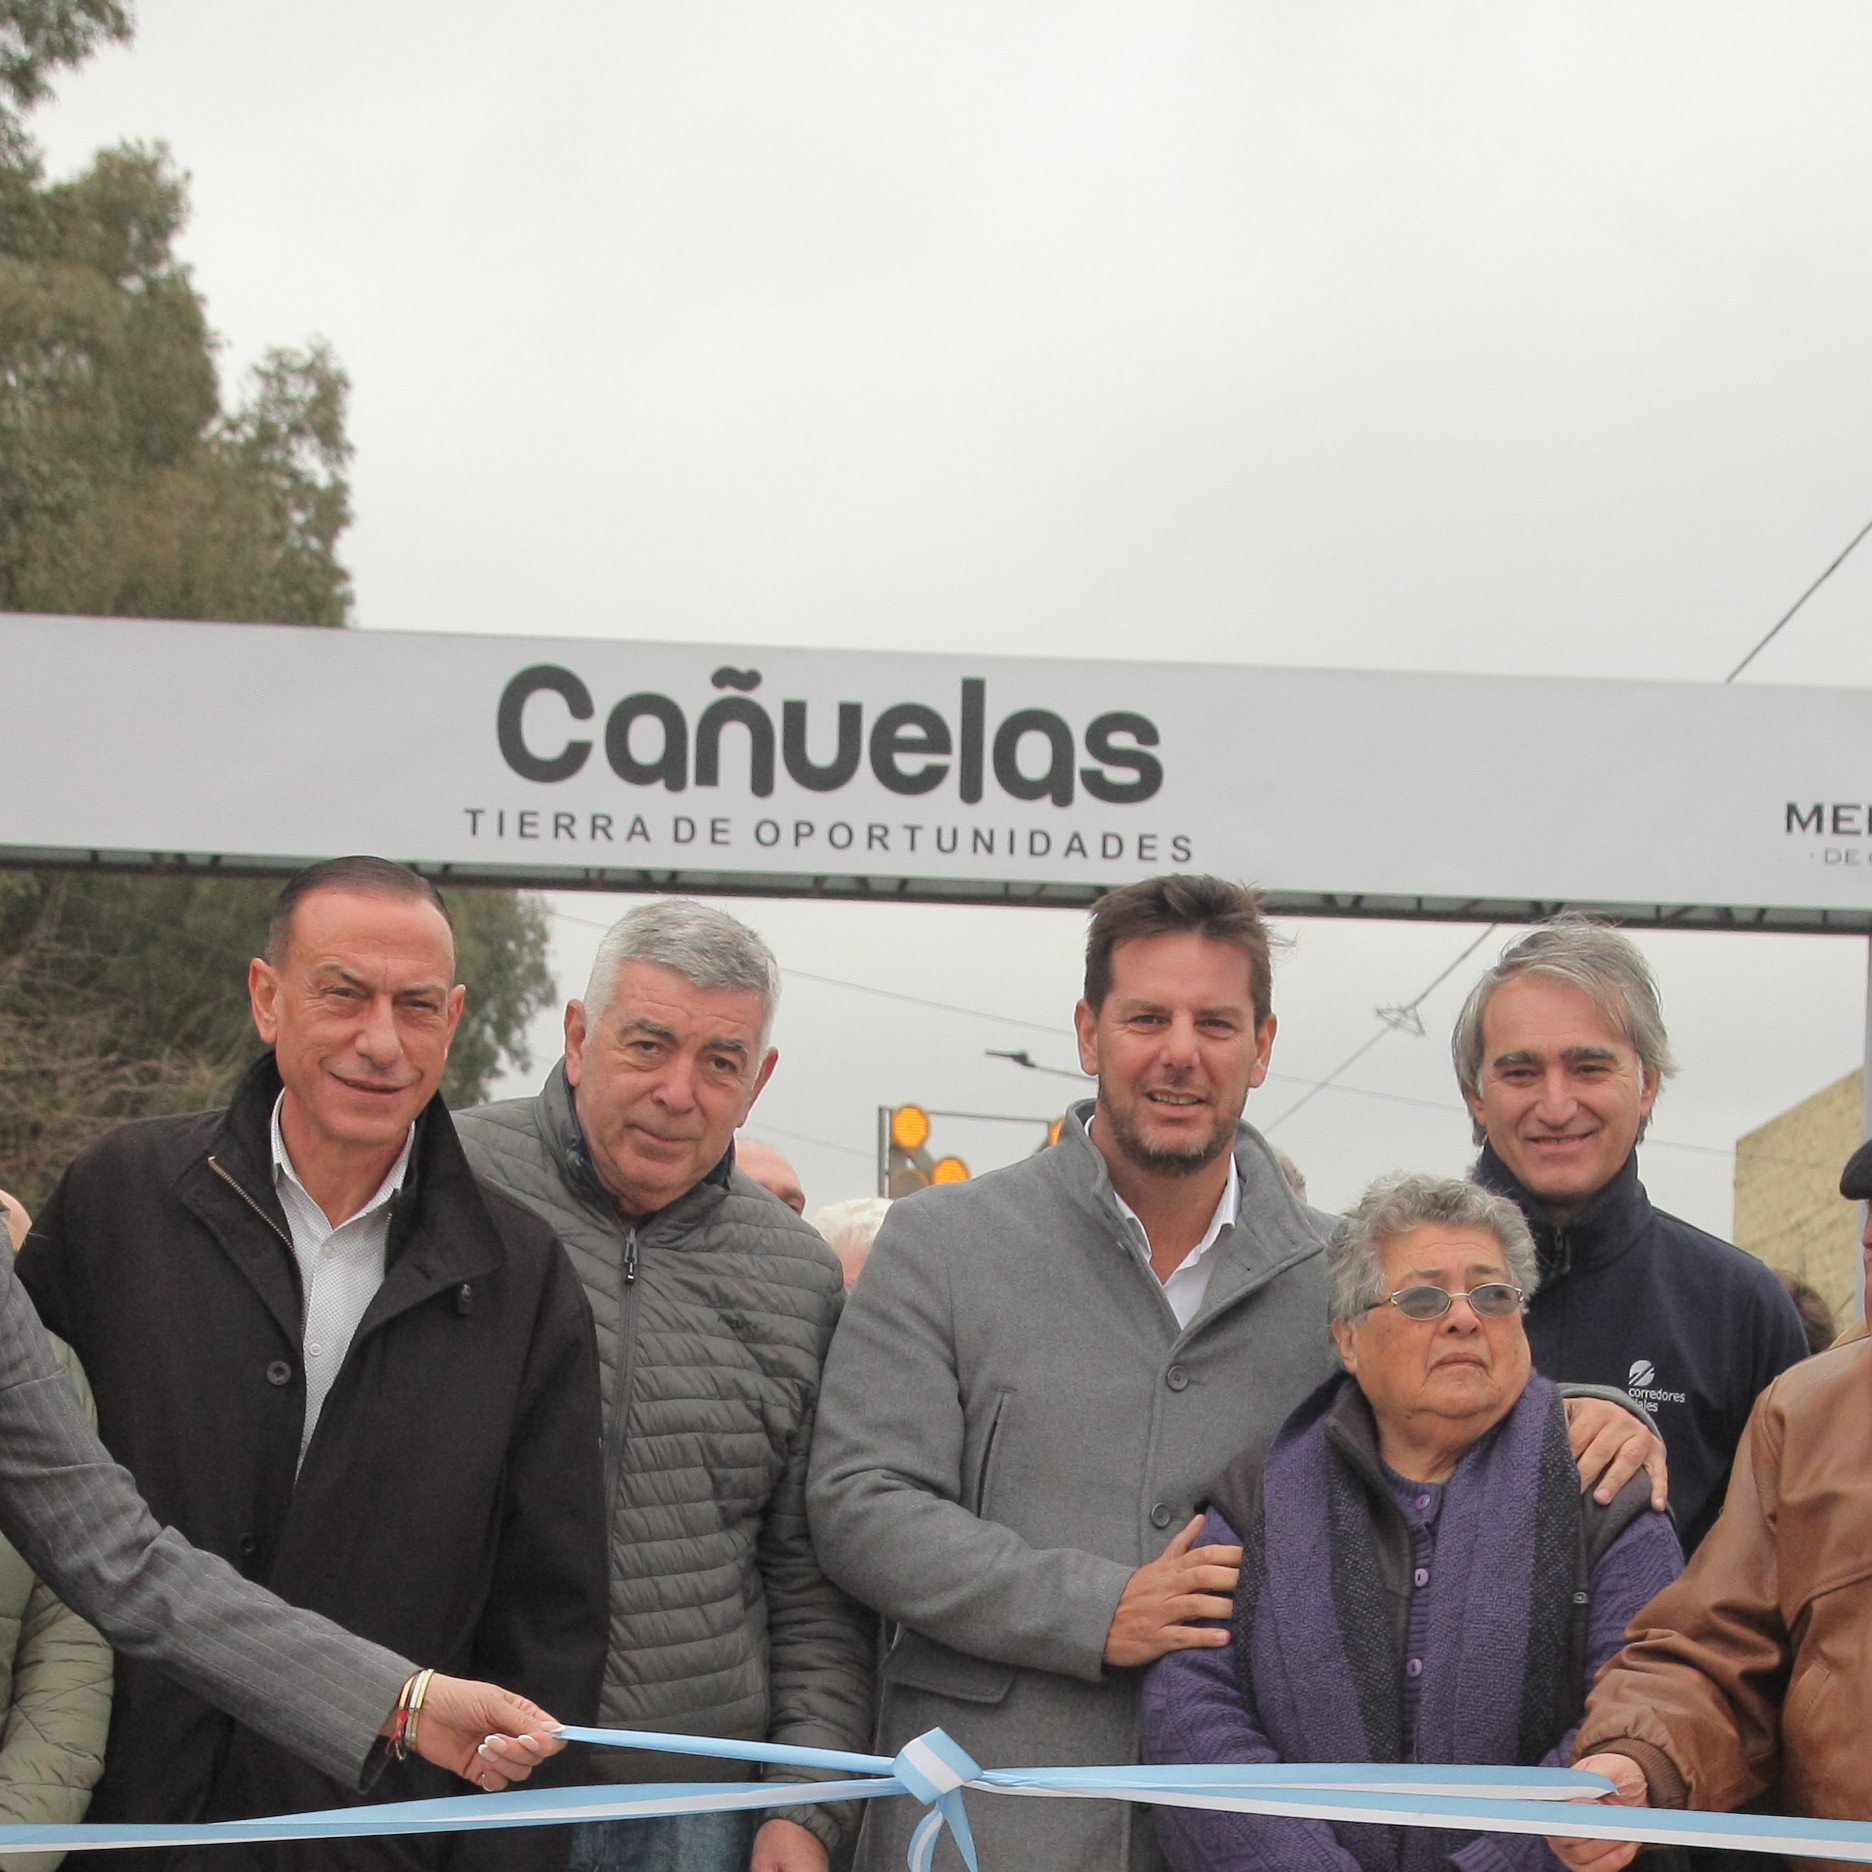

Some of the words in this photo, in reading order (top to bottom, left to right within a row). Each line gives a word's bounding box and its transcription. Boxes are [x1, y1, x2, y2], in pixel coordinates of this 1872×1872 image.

[496, 663, 1164, 808] Cañuelas
[464, 808, 651, 843] TIERRA
[672, 815, 730, 847] DE
[753, 818, 1193, 864] OPORTUNIDADES
[1823, 848, 1861, 867] DE
[1628, 1388, 1685, 1403] corredores
